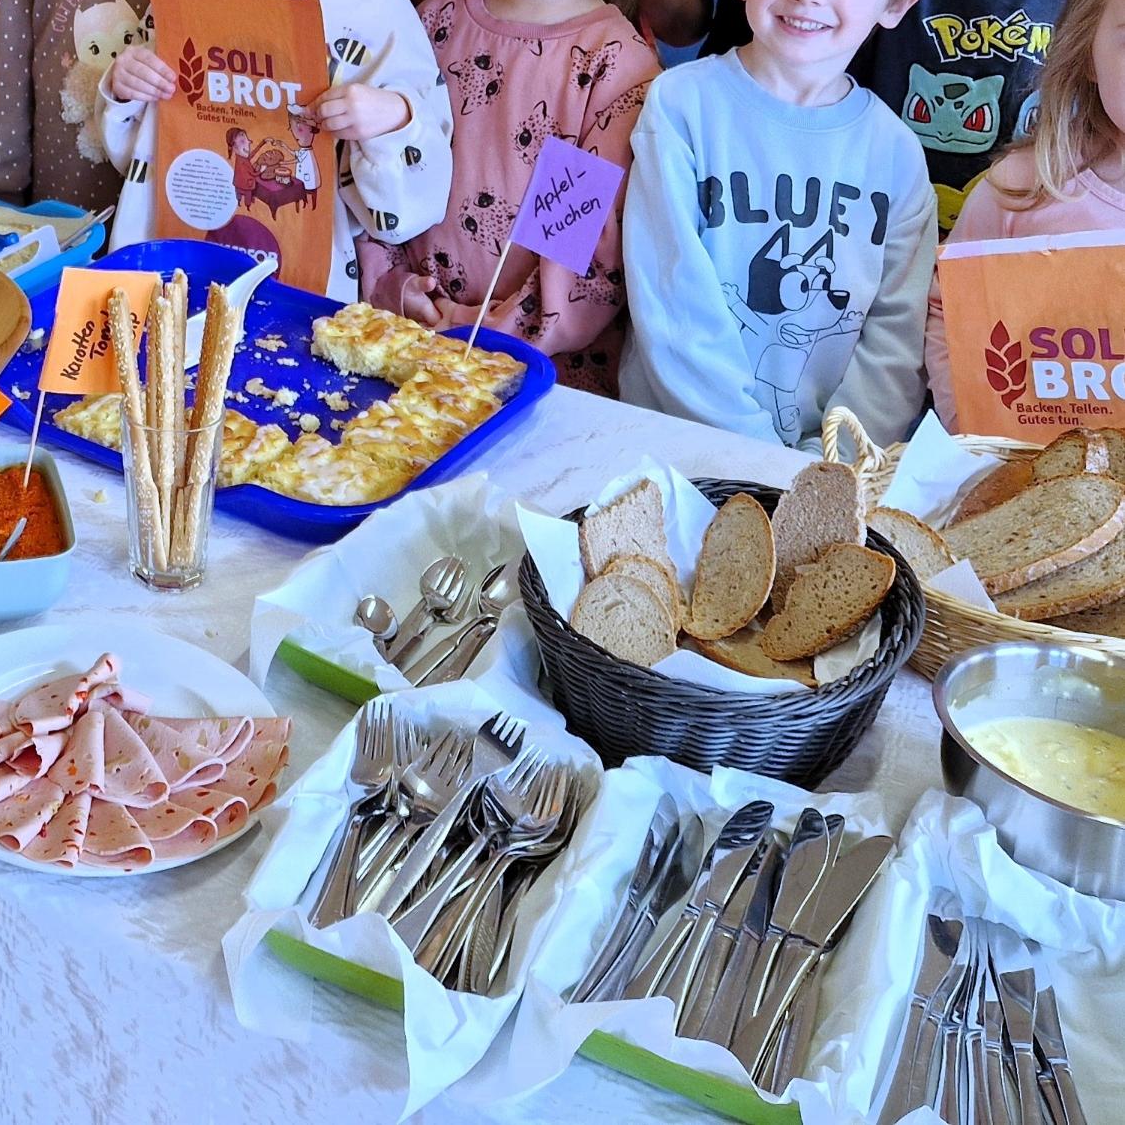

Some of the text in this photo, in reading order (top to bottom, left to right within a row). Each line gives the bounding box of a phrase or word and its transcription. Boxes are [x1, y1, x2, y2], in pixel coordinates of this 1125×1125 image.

[207, 46, 274, 79] SOLI
[207, 71, 302, 110] BROT
[196, 103, 257, 118] Backen. Teilen.
[196, 113, 220, 123] Gutes
[534, 166, 587, 218] Apfel-
[542, 197, 602, 240] kuchen
[60, 320, 95, 381] Karotten
[1028, 326, 1125, 361] SOL
[1031, 360, 1125, 401] BR
[1016, 402, 1113, 415] Backen. Teilen.
[1017, 414, 1084, 426] Gutes tun.
